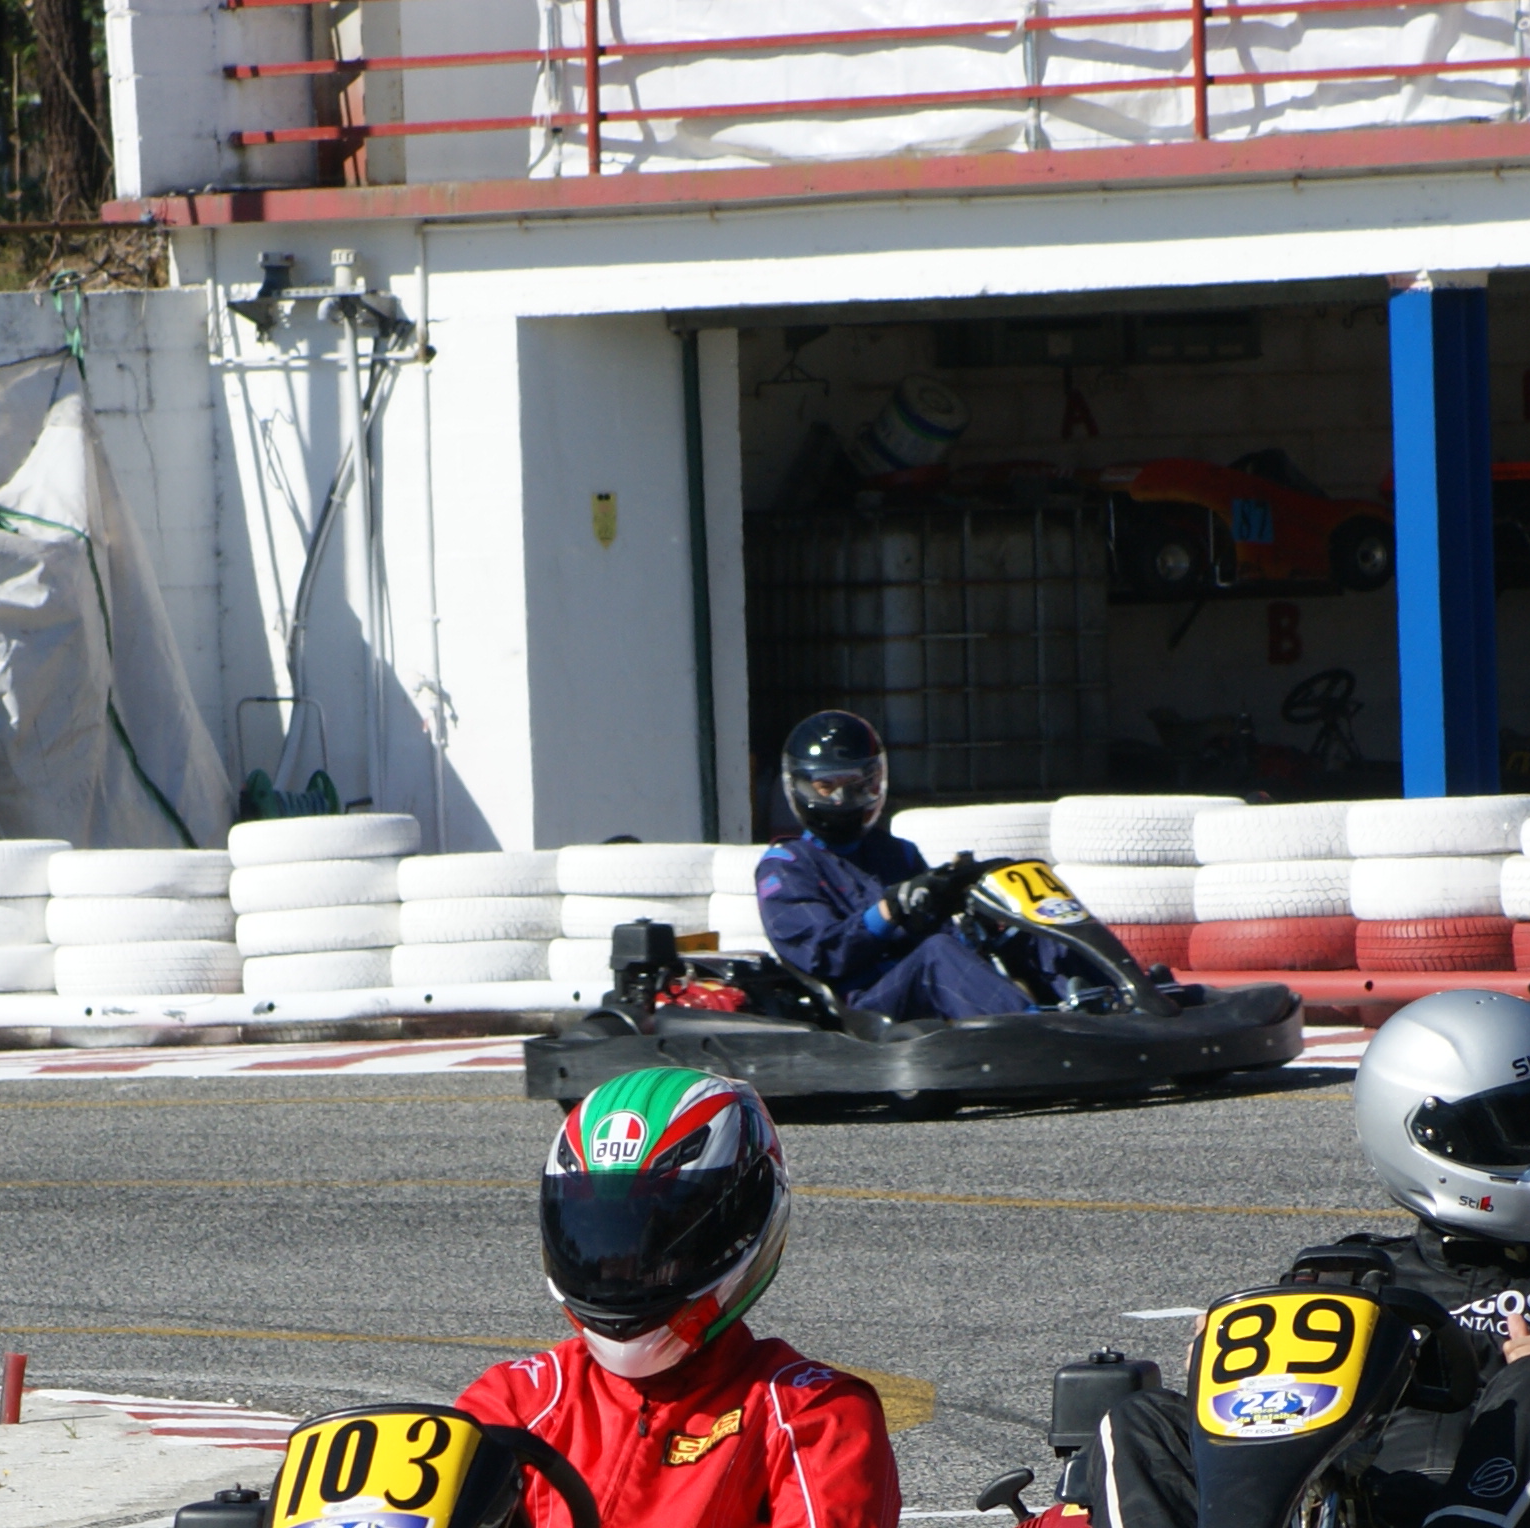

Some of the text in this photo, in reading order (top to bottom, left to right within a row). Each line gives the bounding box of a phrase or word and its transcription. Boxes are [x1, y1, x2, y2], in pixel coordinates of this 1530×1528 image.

[1266, 602, 1305, 665] B
[1006, 867, 1071, 904] 24
[1211, 1297, 1356, 1385] 89
[1239, 1391, 1288, 1415] 24
[284, 1416, 452, 1519] 103
